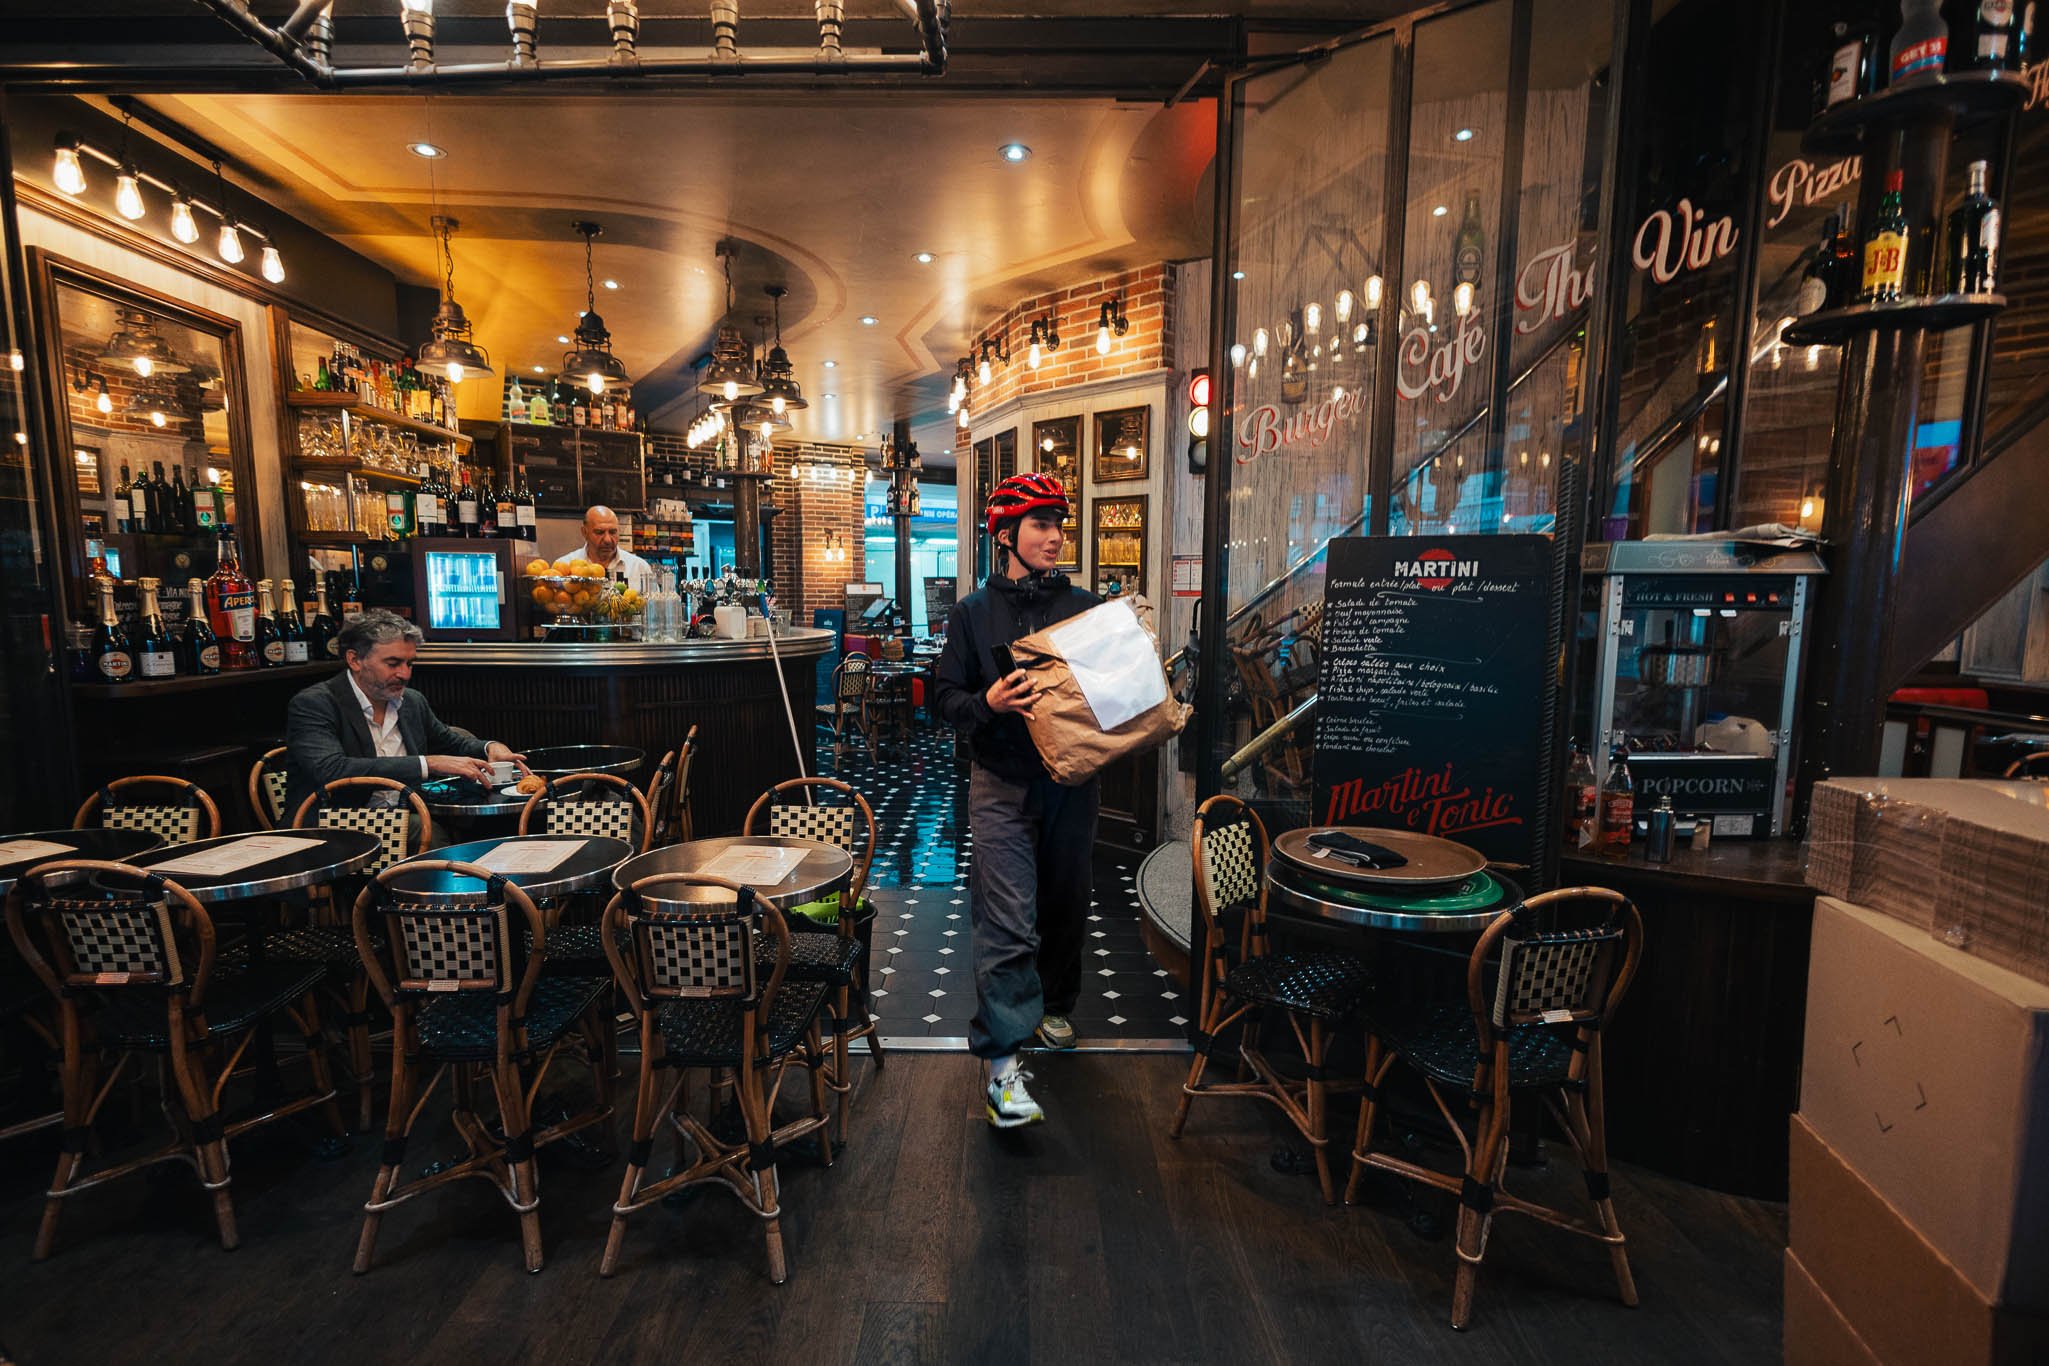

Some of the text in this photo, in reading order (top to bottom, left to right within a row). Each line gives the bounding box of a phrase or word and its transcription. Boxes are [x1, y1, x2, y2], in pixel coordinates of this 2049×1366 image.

[1900, 41, 1928, 64] GET
[1766, 154, 1863, 229] Pizza
[1632, 197, 1740, 284] Vin
[1867, 246, 1901, 275] J&B
[1396, 305, 1487, 403] Café
[1236, 386, 1366, 464] Burger
[1394, 561, 1479, 577] MARTINI
[1431, 584, 1445, 592] ou
[1369, 597, 1379, 607] de
[1359, 626, 1370, 635] de
[1369, 618, 1410, 628] campagne
[1363, 635, 1383, 644] verte
[1419, 661, 1446, 673] choix
[1325, 761, 1453, 827] Martini
[1642, 778, 1744, 794] POPCORN
[1423, 786, 1521, 837] Tonic
